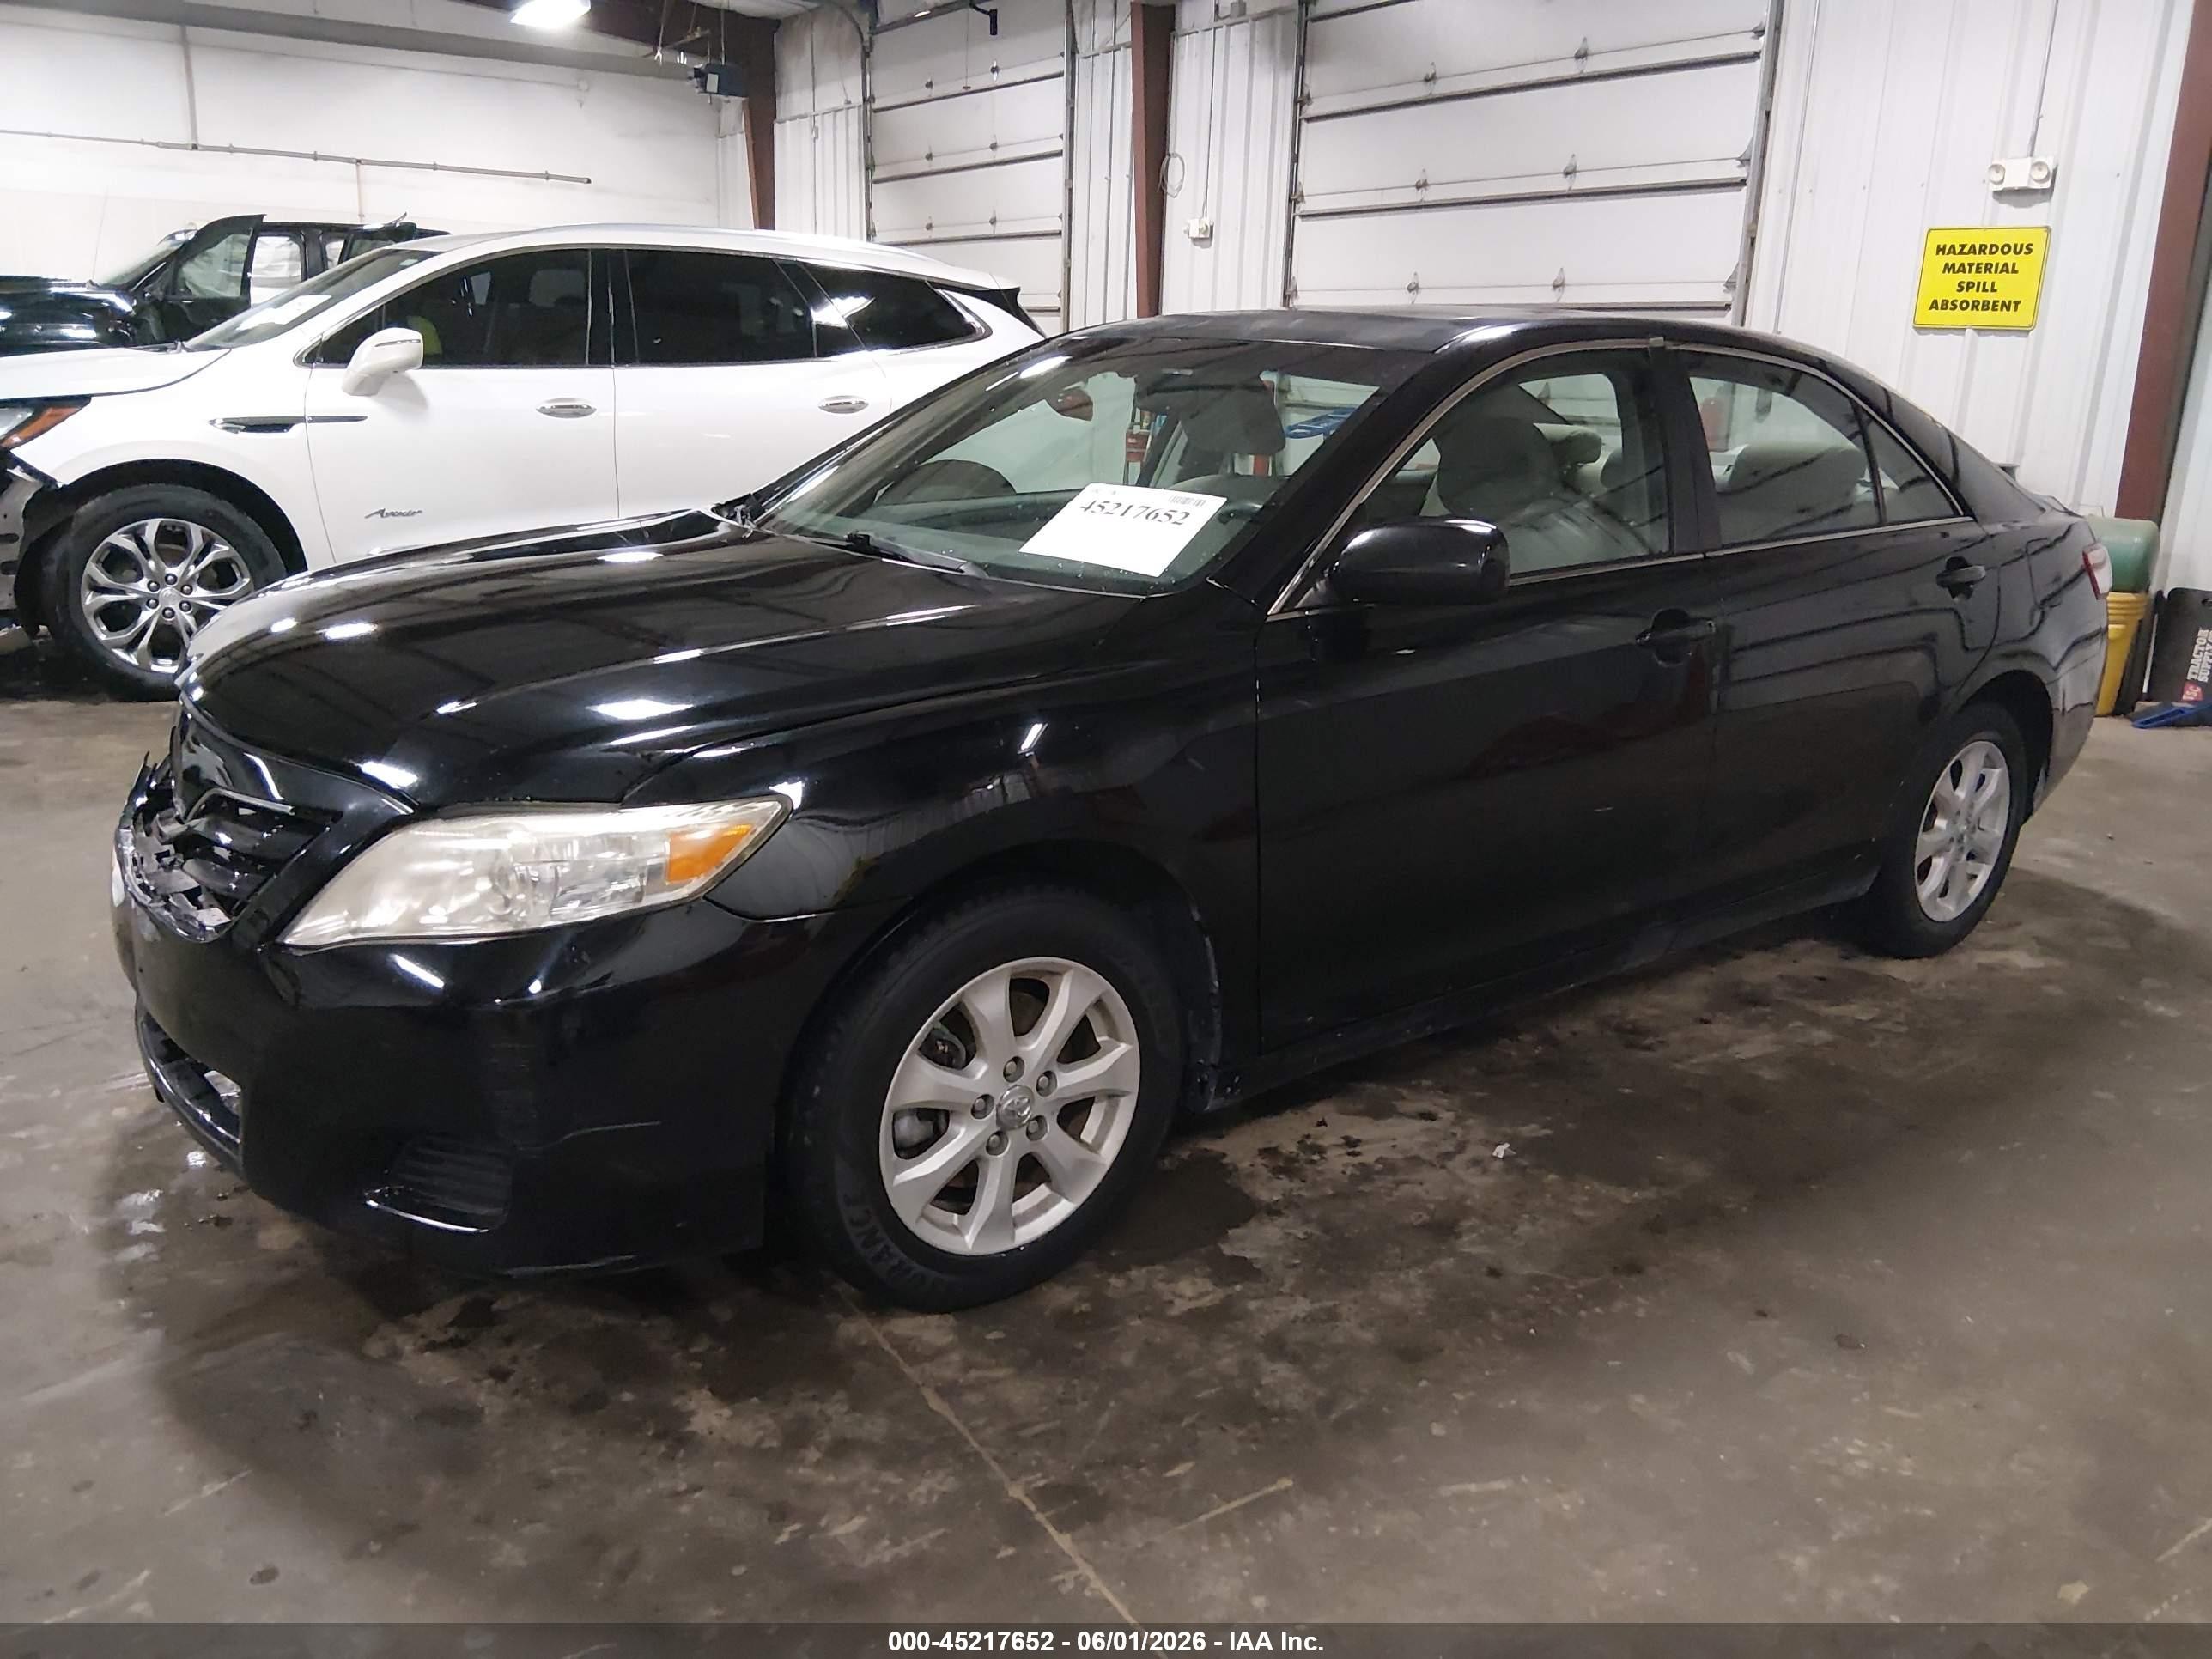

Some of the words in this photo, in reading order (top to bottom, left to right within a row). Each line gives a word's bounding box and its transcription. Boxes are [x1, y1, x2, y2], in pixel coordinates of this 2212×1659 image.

[1936, 243, 2034, 256] HAZARDOUS
[1942, 262, 2019, 275] MATERIAL
[1955, 281, 1998, 293] SPILL
[1929, 299, 2021, 313] ABSORBENT
[1079, 499, 1190, 526] 45217652
